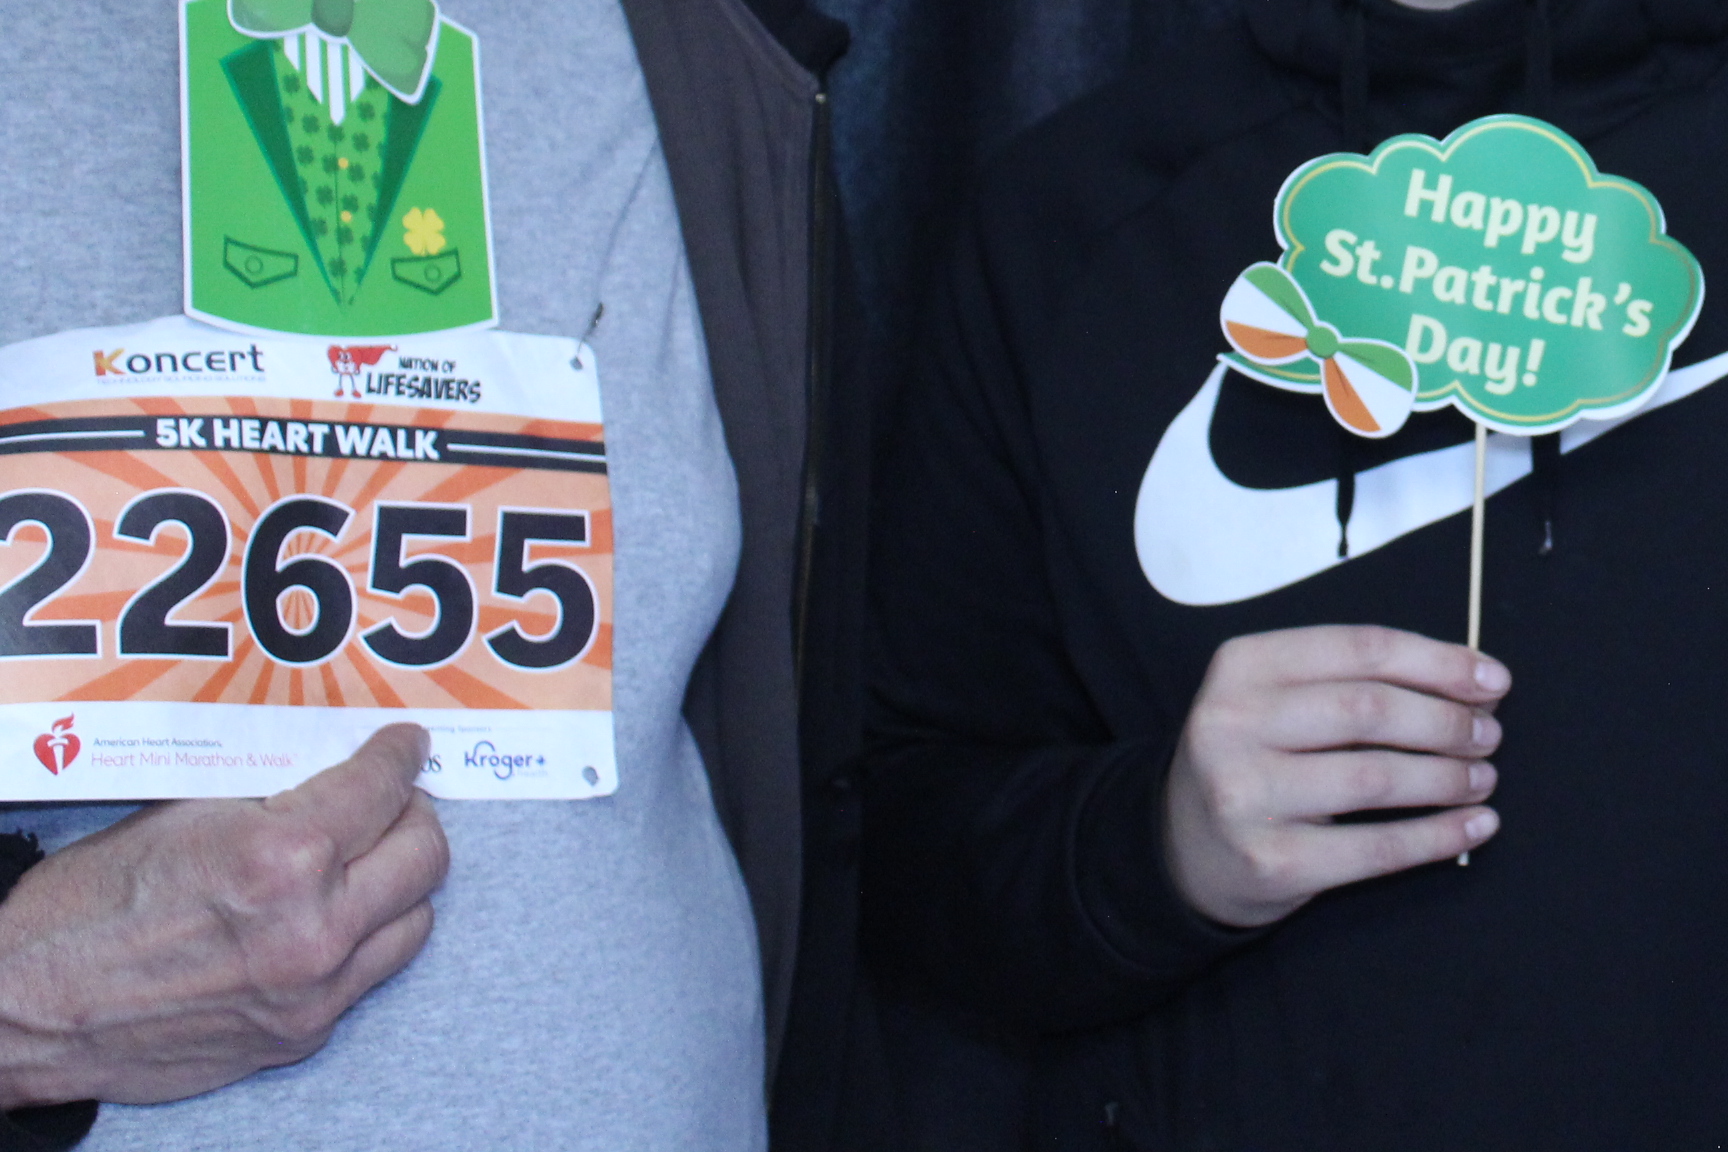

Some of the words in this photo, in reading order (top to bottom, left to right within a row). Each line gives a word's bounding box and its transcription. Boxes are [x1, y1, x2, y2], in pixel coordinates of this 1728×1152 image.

[1404, 169, 1598, 264] Happy
[93, 343, 265, 376] Koncert
[399, 356, 438, 371] NATION
[441, 359, 456, 373] OF
[1405, 313, 1547, 395] Day!
[366, 372, 481, 403] LIFESAVERS
[155, 418, 207, 448] 5K
[213, 418, 329, 454] HEART
[335, 424, 440, 460] WALK
[0, 487, 599, 672] 22655
[93, 737, 140, 747] American
[142, 737, 169, 747] Heart
[91, 752, 135, 767] Heart
[139, 752, 171, 766] Mini
[175, 752, 244, 767] Marathon
[246, 753, 258, 767] &
[259, 753, 294, 767] Walk
